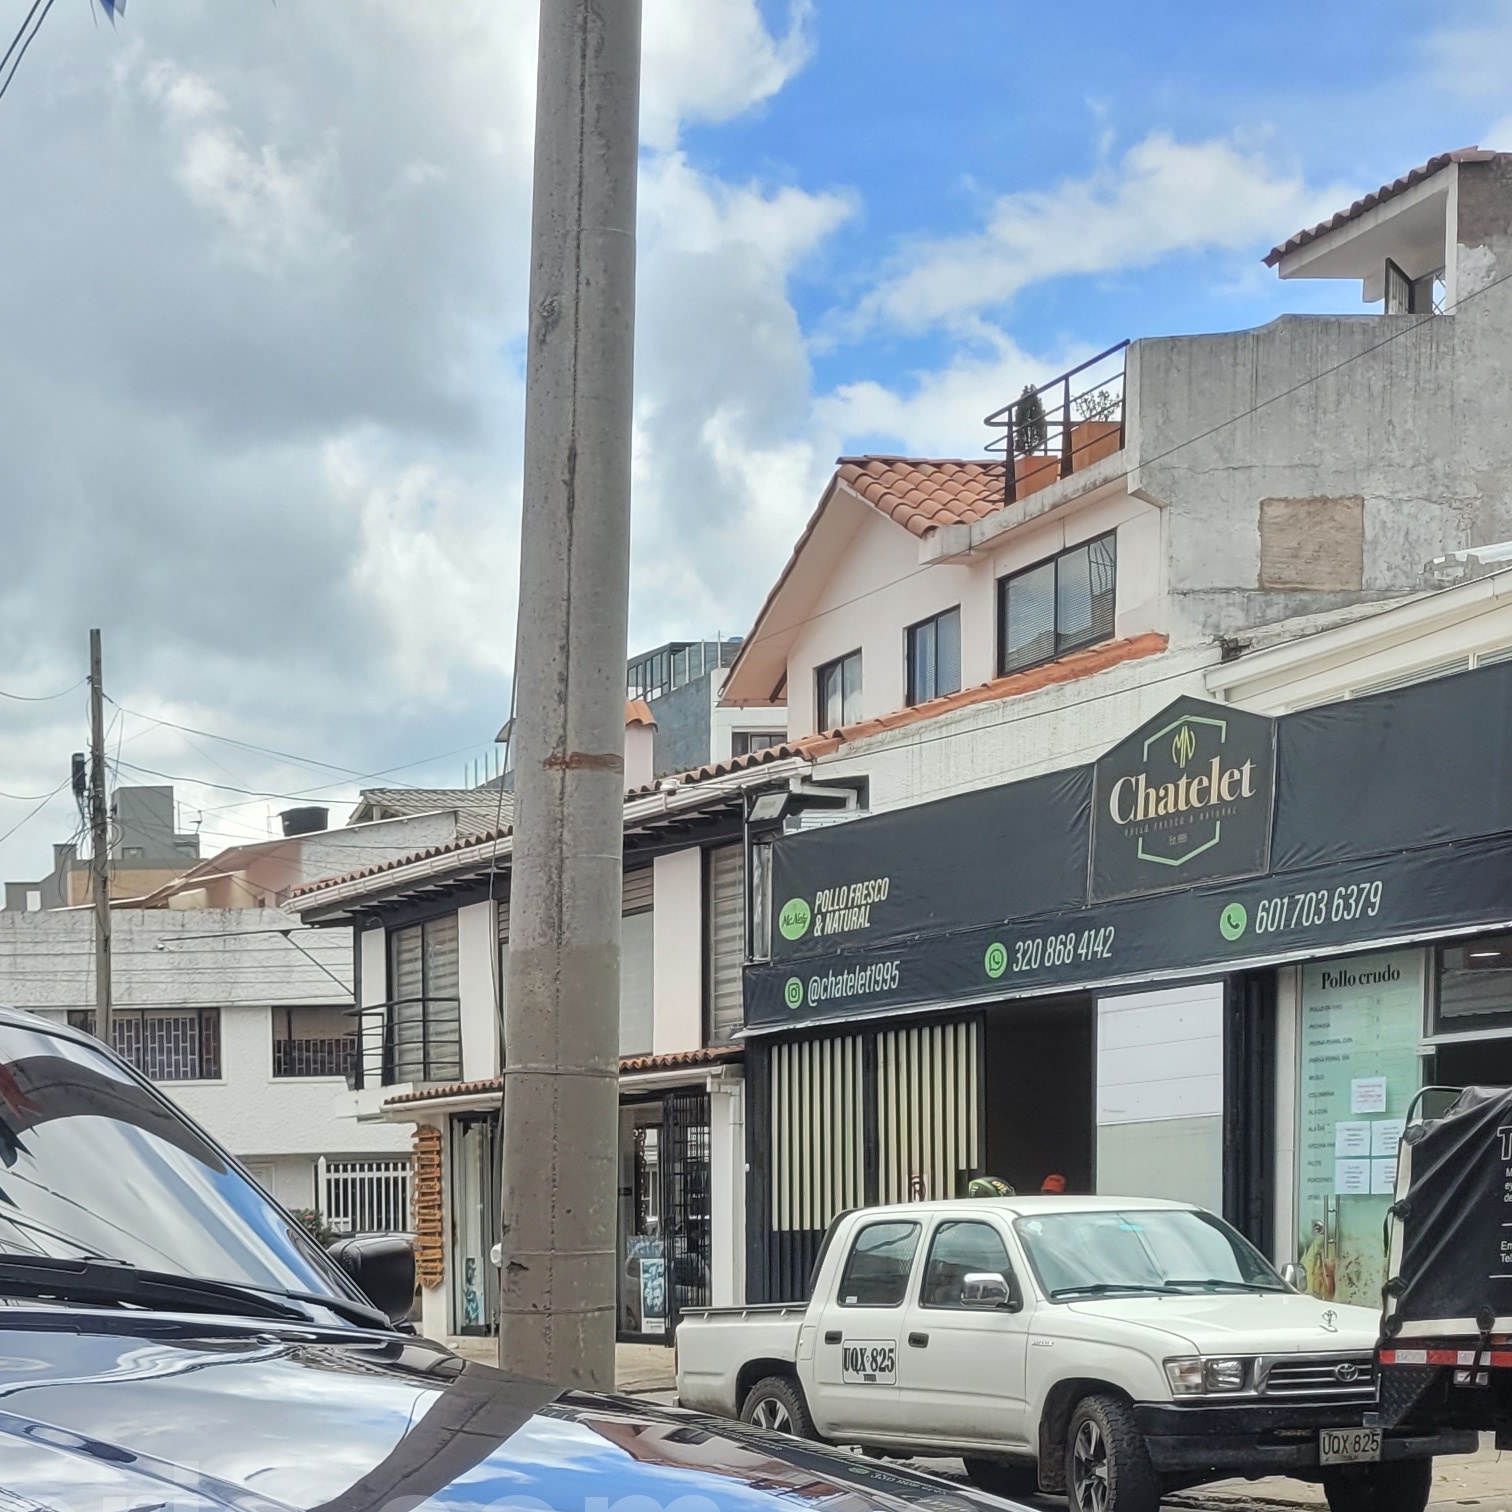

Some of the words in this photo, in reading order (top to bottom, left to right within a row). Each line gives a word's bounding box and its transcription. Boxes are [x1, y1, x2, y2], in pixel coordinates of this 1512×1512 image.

[1109, 755, 1256, 825] Chatelet
[814, 885, 849, 914] POLLO
[849, 877, 890, 906] FRESCO
[1255, 895, 1290, 934] 601
[1290, 889, 1328, 928] 703
[1331, 880, 1383, 922] 6379
[813, 916, 823, 937] &
[824, 905, 871, 936] NATURAL
[1013, 938, 1043, 972] 320
[1044, 932, 1076, 967] 868
[1077, 926, 1115, 962] 4142
[807, 961, 901, 1006] @chatelet1995
[1321, 969, 1356, 990] Pollo
[1358, 964, 1401, 986] crudo
[843, 1347, 867, 1375] UQX
[870, 1347, 895, 1373] 825
[1353, 1433, 1380, 1453] 825
